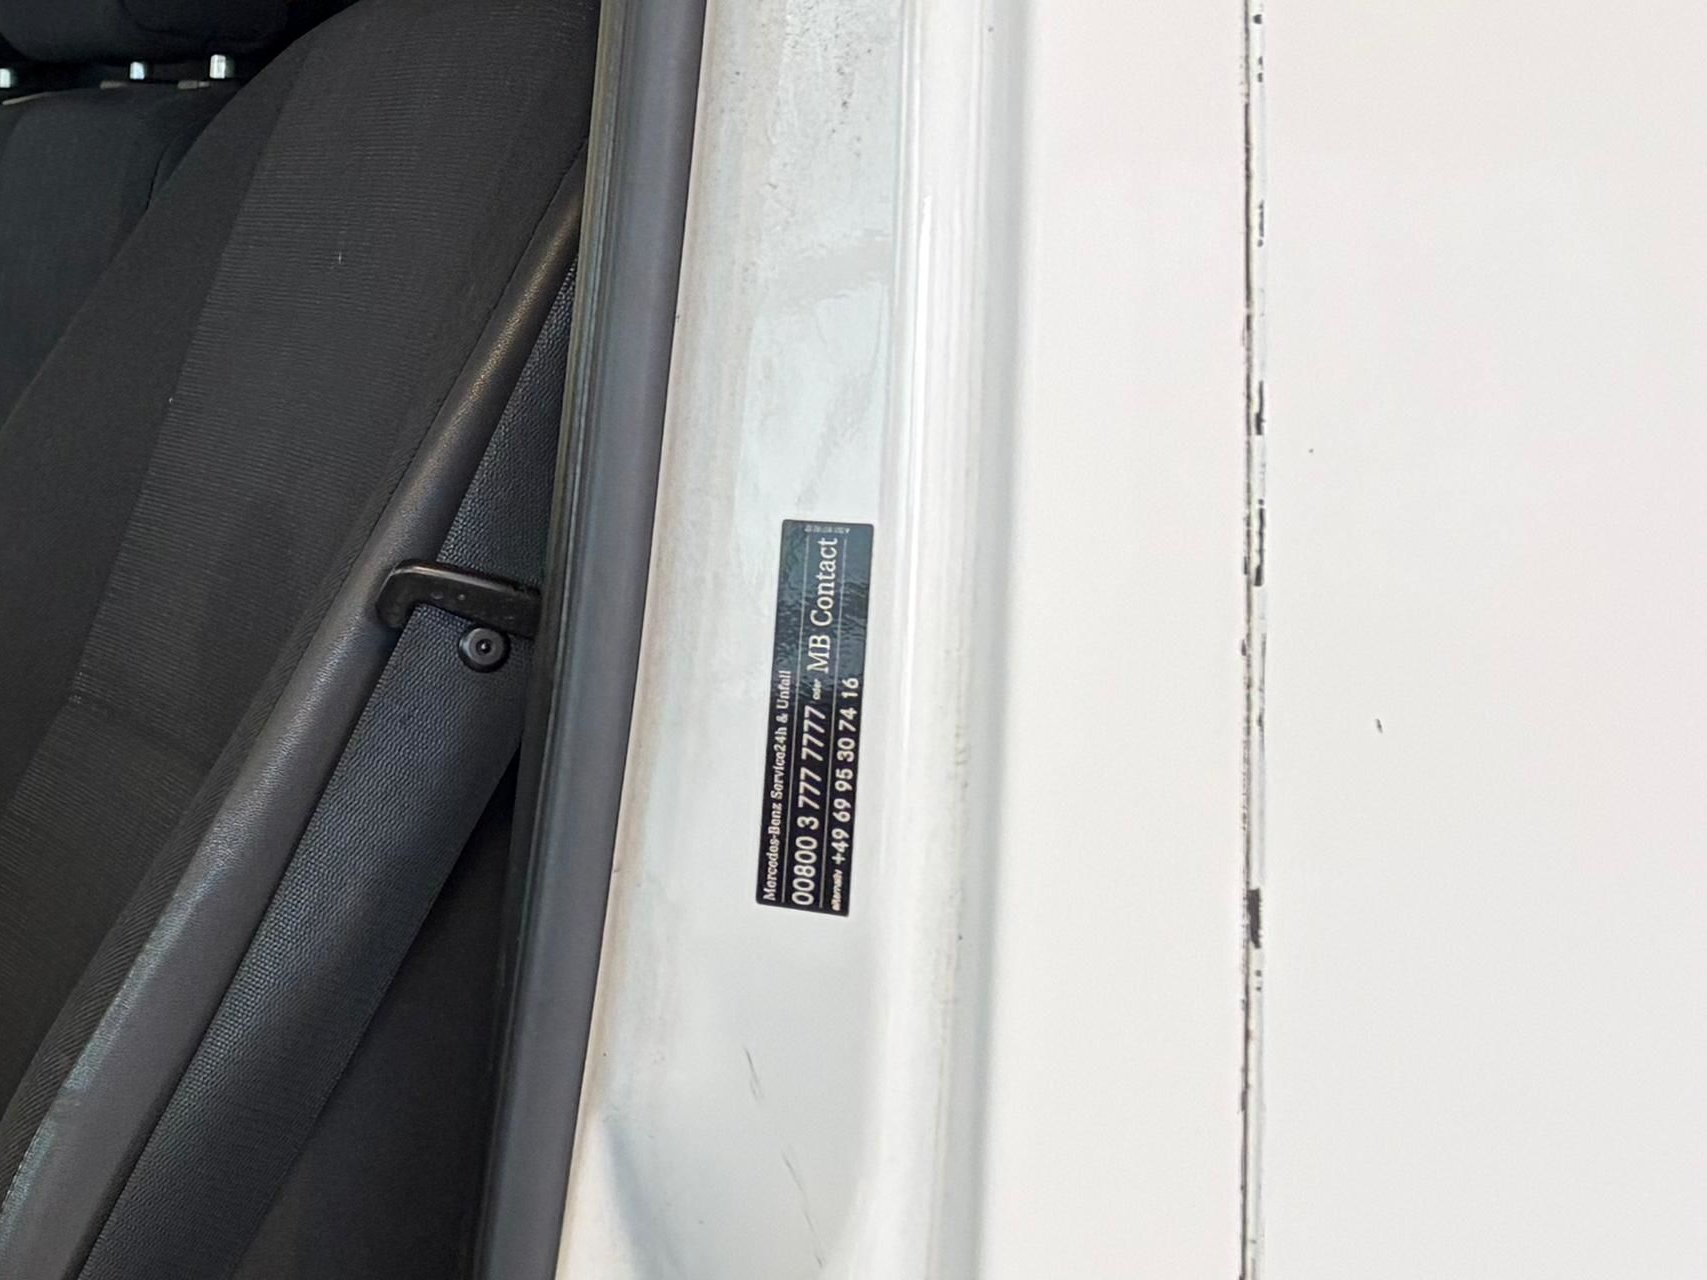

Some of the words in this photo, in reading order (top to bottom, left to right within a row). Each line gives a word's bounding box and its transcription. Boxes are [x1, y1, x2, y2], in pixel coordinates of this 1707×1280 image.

[809, 537, 838, 626] Contact
[807, 634, 831, 674] MB
[777, 670, 792, 710] Unfall
[841, 678, 859, 699] 16
[777, 714, 788, 724] &
[801, 706, 827, 761] 7777
[839, 707, 857, 732] 74
[771, 726, 788, 800] Service24h
[837, 738, 855, 762] 30
[798, 766, 823, 808] 777
[835, 768, 853, 792] 95
[797, 816, 819, 830] 3
[833, 798, 852, 823] 69
[763, 803, 783, 901] Mercedes-Benz
[831, 828, 849, 866] +49
[792, 837, 819, 906] 00800
